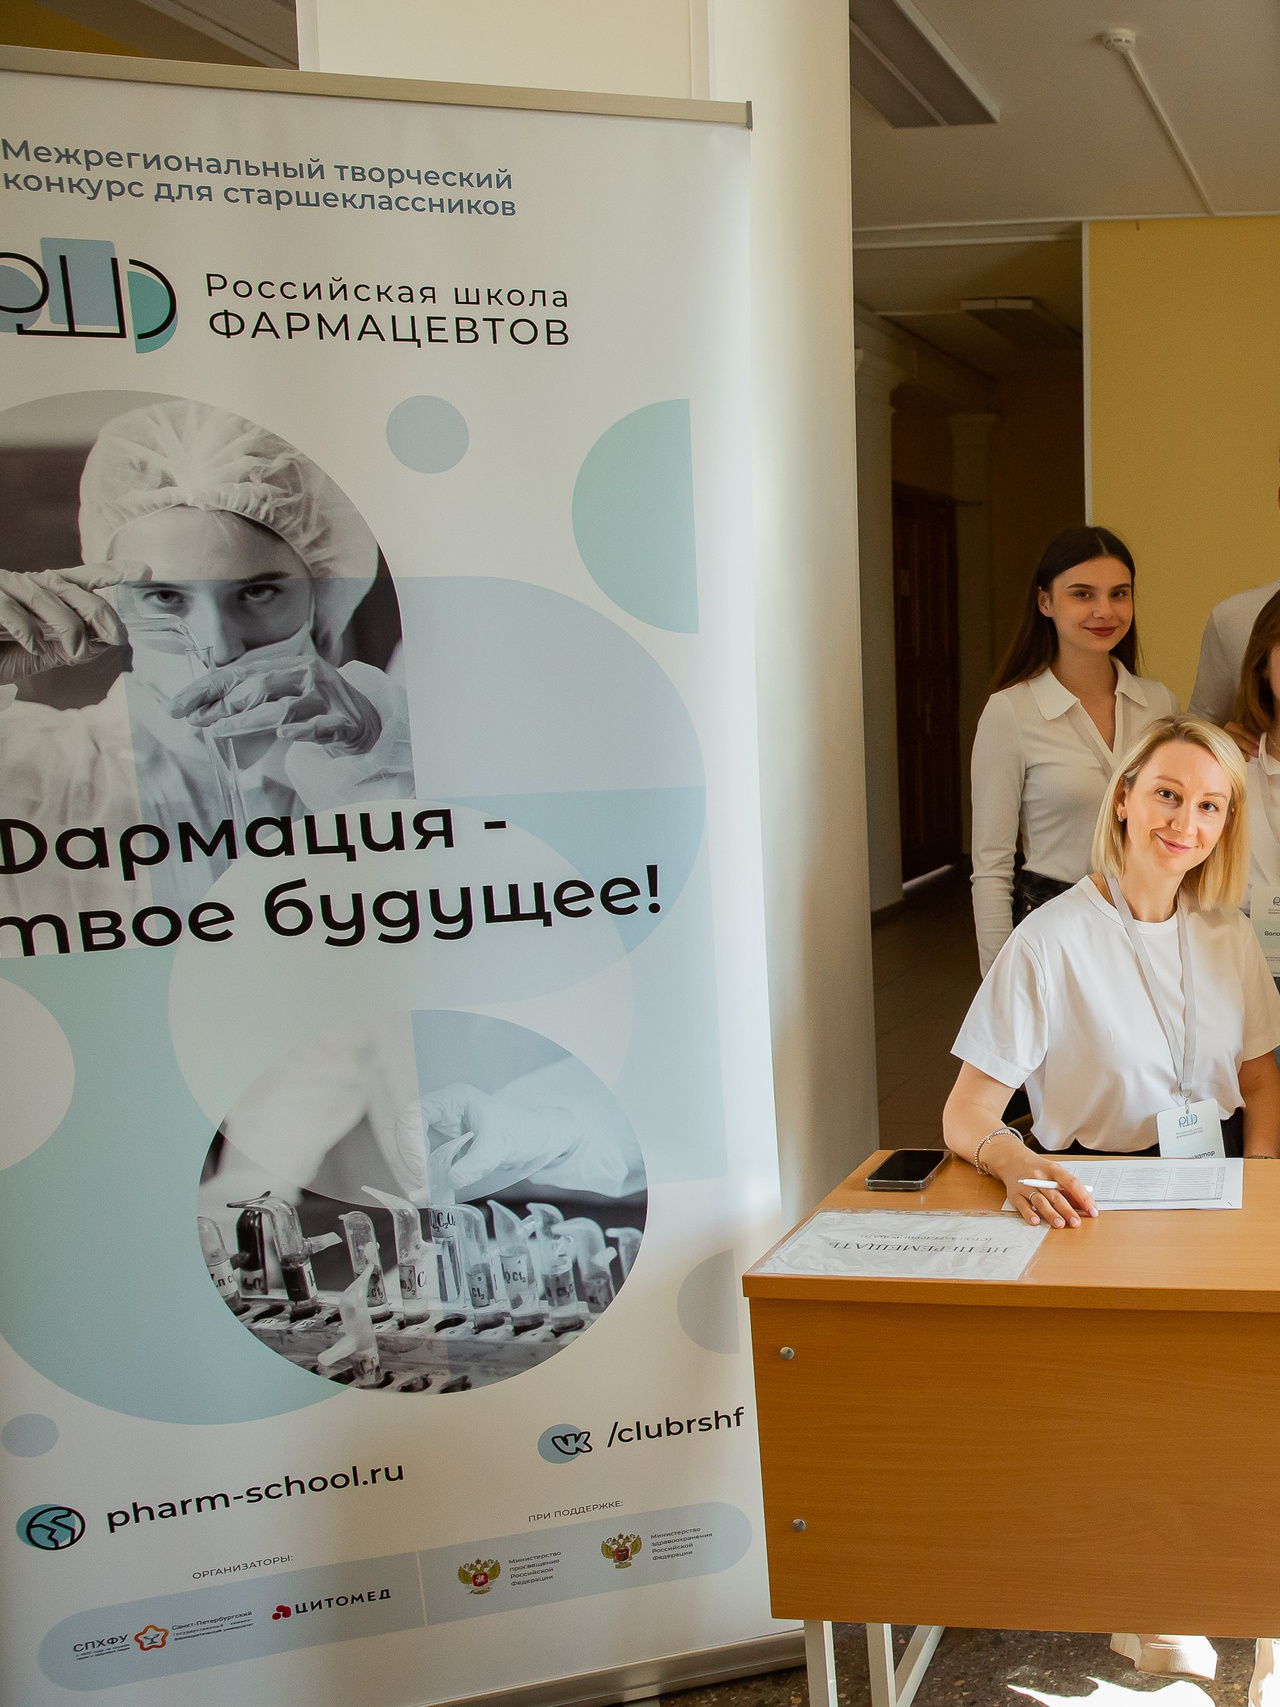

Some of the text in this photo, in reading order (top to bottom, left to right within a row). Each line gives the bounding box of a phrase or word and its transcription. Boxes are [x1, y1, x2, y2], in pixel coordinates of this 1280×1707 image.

[2, 138, 513, 190] Межрегиональный творческий
[4, 172, 516, 217] конкурс для старшеклассников
[205, 273, 569, 308] Российская школа
[208, 308, 570, 348] ФАРМАЦЕВТОВ
[0, 808, 455, 881] Фармация
[0, 864, 660, 957] твое будущее!
[606, 1406, 745, 1448] /clubrshf
[106, 1465, 404, 1533] pharm-school.ru
[528, 1500, 624, 1522] ПРИ ПОДДЕРЖКЕ:
[650, 1527, 701, 1540] Министерство
[651, 1532, 713, 1547] здравоохранения
[508, 1550, 562, 1564] Министерство
[651, 1542, 694, 1554] Российской
[652, 1550, 693, 1561] Федерации
[192, 1554, 294, 1580] ОРГАНИЗАТОРЫ:
[509, 1559, 560, 1572] просвещения
[510, 1566, 554, 1579] Российской
[511, 1575, 554, 1586] Федерации
[295, 1588, 391, 1615] ЦИТОМЕД
[171, 1610, 252, 1631] Санкт-Петербургский
[73, 1633, 129, 1653] СПХФУ
